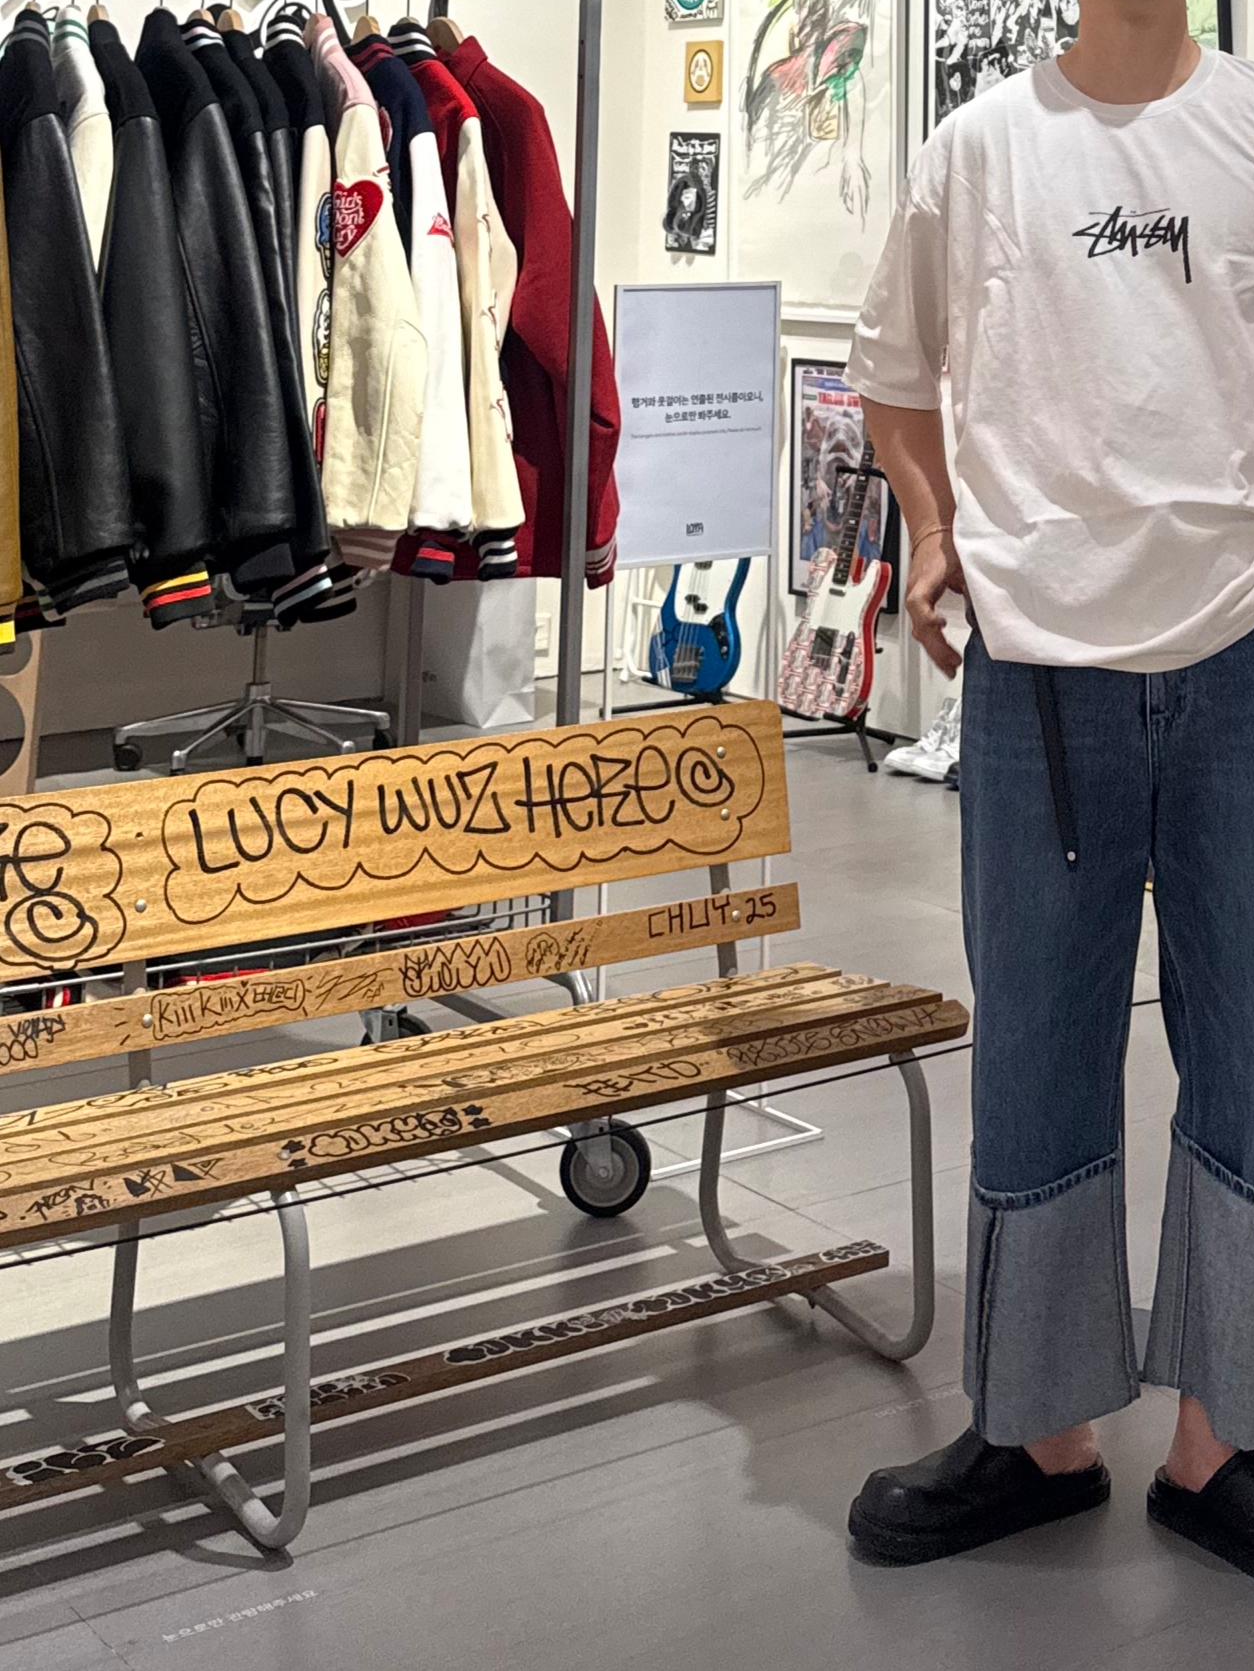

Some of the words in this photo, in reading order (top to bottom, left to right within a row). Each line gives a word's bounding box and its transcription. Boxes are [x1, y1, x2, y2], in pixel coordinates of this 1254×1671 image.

[189, 779, 354, 874] LUCY
[378, 761, 511, 836] WUZ
[649, 895, 730, 938] CHUY
[745, 893, 776, 925] 25
